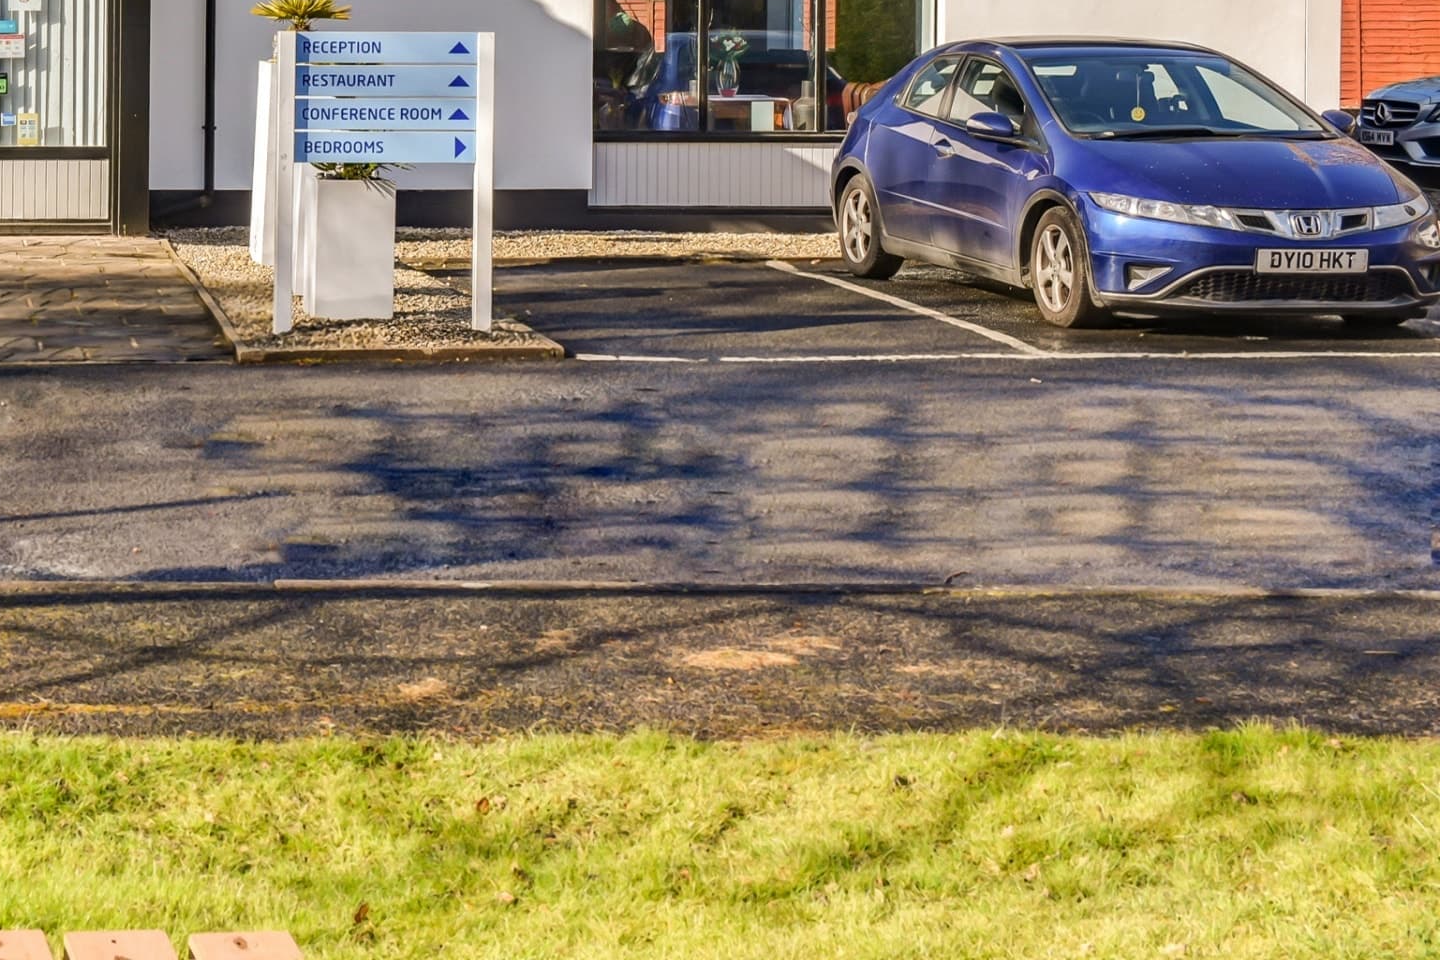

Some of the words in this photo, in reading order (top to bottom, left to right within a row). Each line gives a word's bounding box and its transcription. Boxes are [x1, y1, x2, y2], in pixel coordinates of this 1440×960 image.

[302, 41, 382, 54] RECEPTION
[302, 74, 396, 87] RESTAURANT
[302, 107, 396, 121] CONFERENCE
[400, 107, 442, 121] ROOM
[304, 140, 384, 154] BEDROOMS
[1270, 251, 1314, 269] DY10
[1319, 251, 1357, 269] HKT
